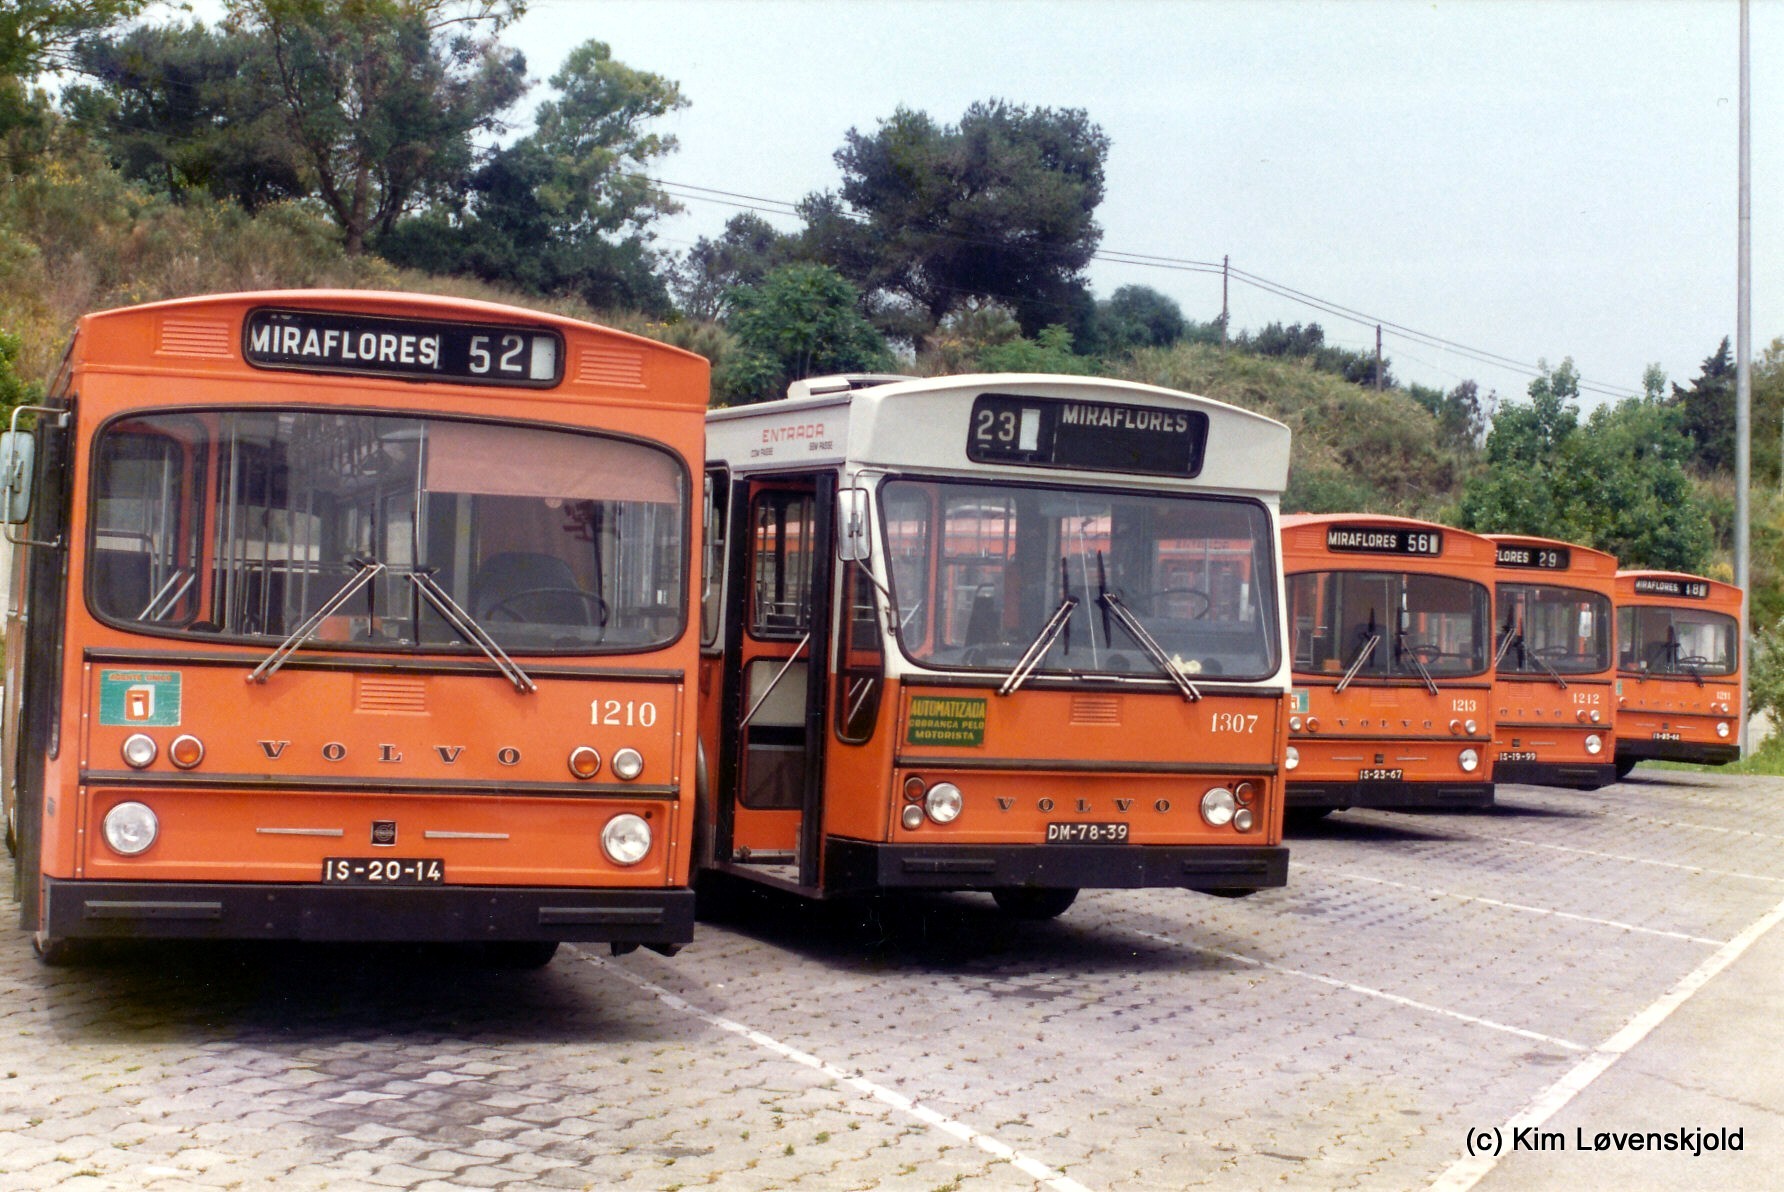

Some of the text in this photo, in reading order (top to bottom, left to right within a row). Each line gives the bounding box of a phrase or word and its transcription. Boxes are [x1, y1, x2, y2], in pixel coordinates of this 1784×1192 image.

[250, 325, 524, 373] MIRAFLORES 52
[977, 404, 1187, 441] 23 MIRAFLORES
[762, 423, 824, 443] ENTRADA
[1328, 532, 1397, 548] MIRAFLORES
[1539, 552, 1557, 567] 29
[1452, 699, 1477, 712] 1213
[1573, 693, 1599, 704] 1212
[590, 700, 657, 727] 1210
[911, 700, 985, 718] AUTOMATIZADA
[962, 721, 985, 729] PELO
[1211, 713, 1258, 733] 1307
[1336, 718, 1433, 729] VOLVO
[915, 730, 974, 739] MOTORISTA
[258, 741, 522, 766] VOLVO
[995, 797, 1171, 813] VOLVO
[1048, 824, 1128, 840] DM-78-39
[326, 861, 441, 881] IS-20-14
